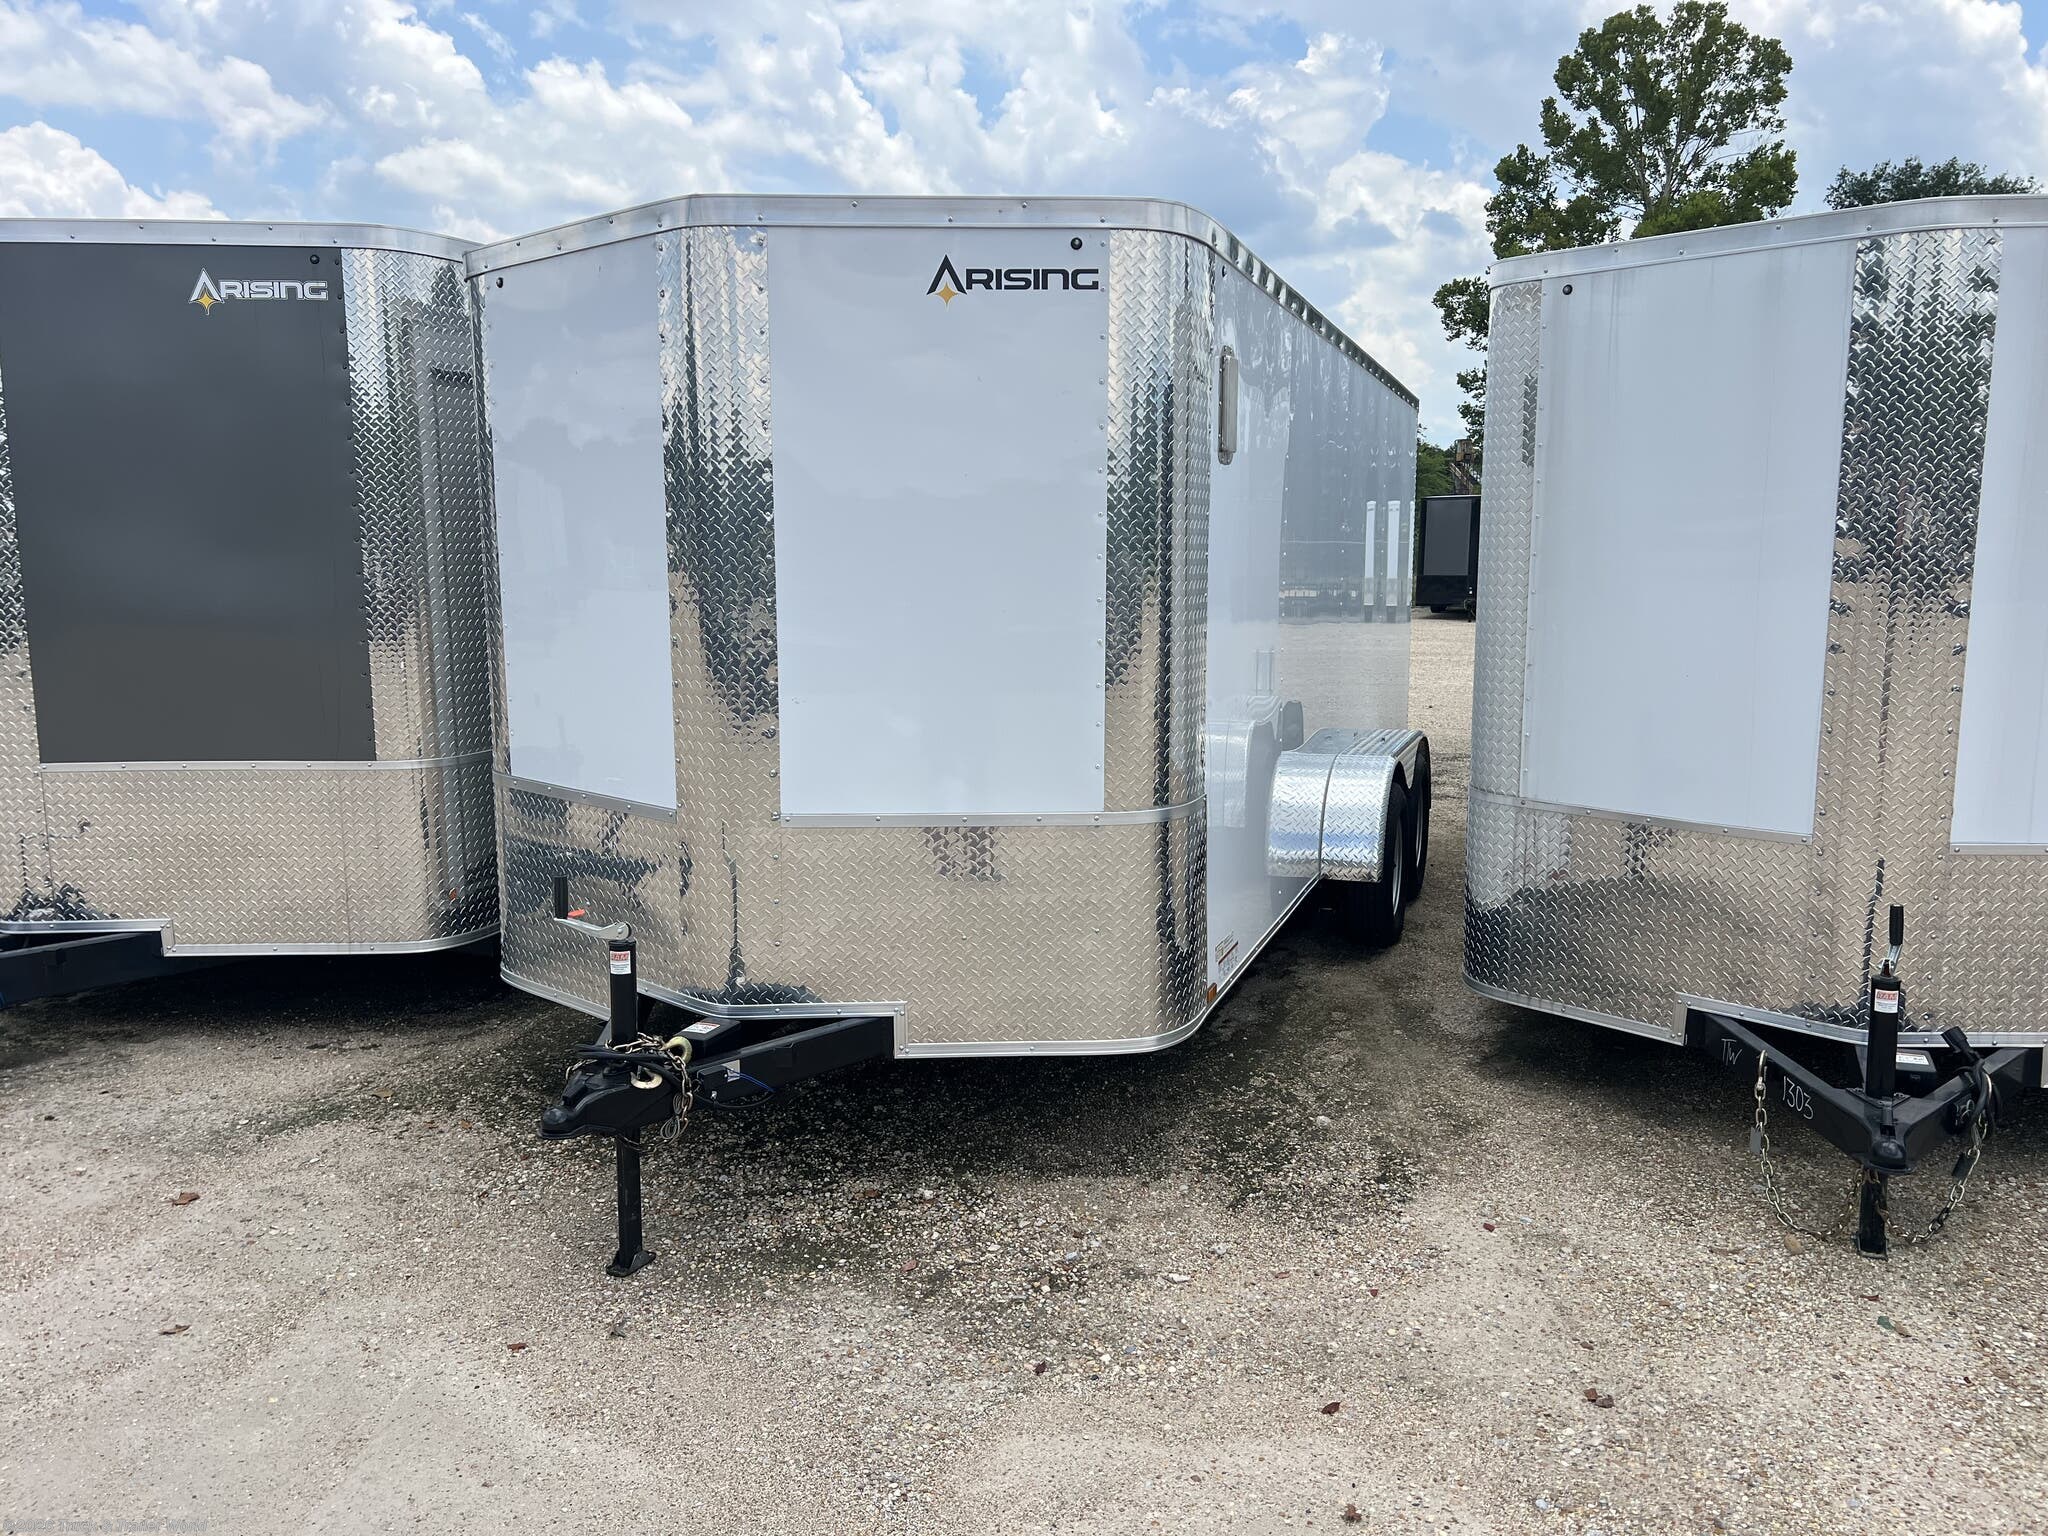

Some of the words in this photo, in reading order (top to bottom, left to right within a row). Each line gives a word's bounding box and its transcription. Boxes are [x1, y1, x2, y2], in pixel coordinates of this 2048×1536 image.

[189, 268, 329, 304] ARISING
[926, 254, 1099, 296] ARISING
[1782, 1075, 1814, 1120] 1303
